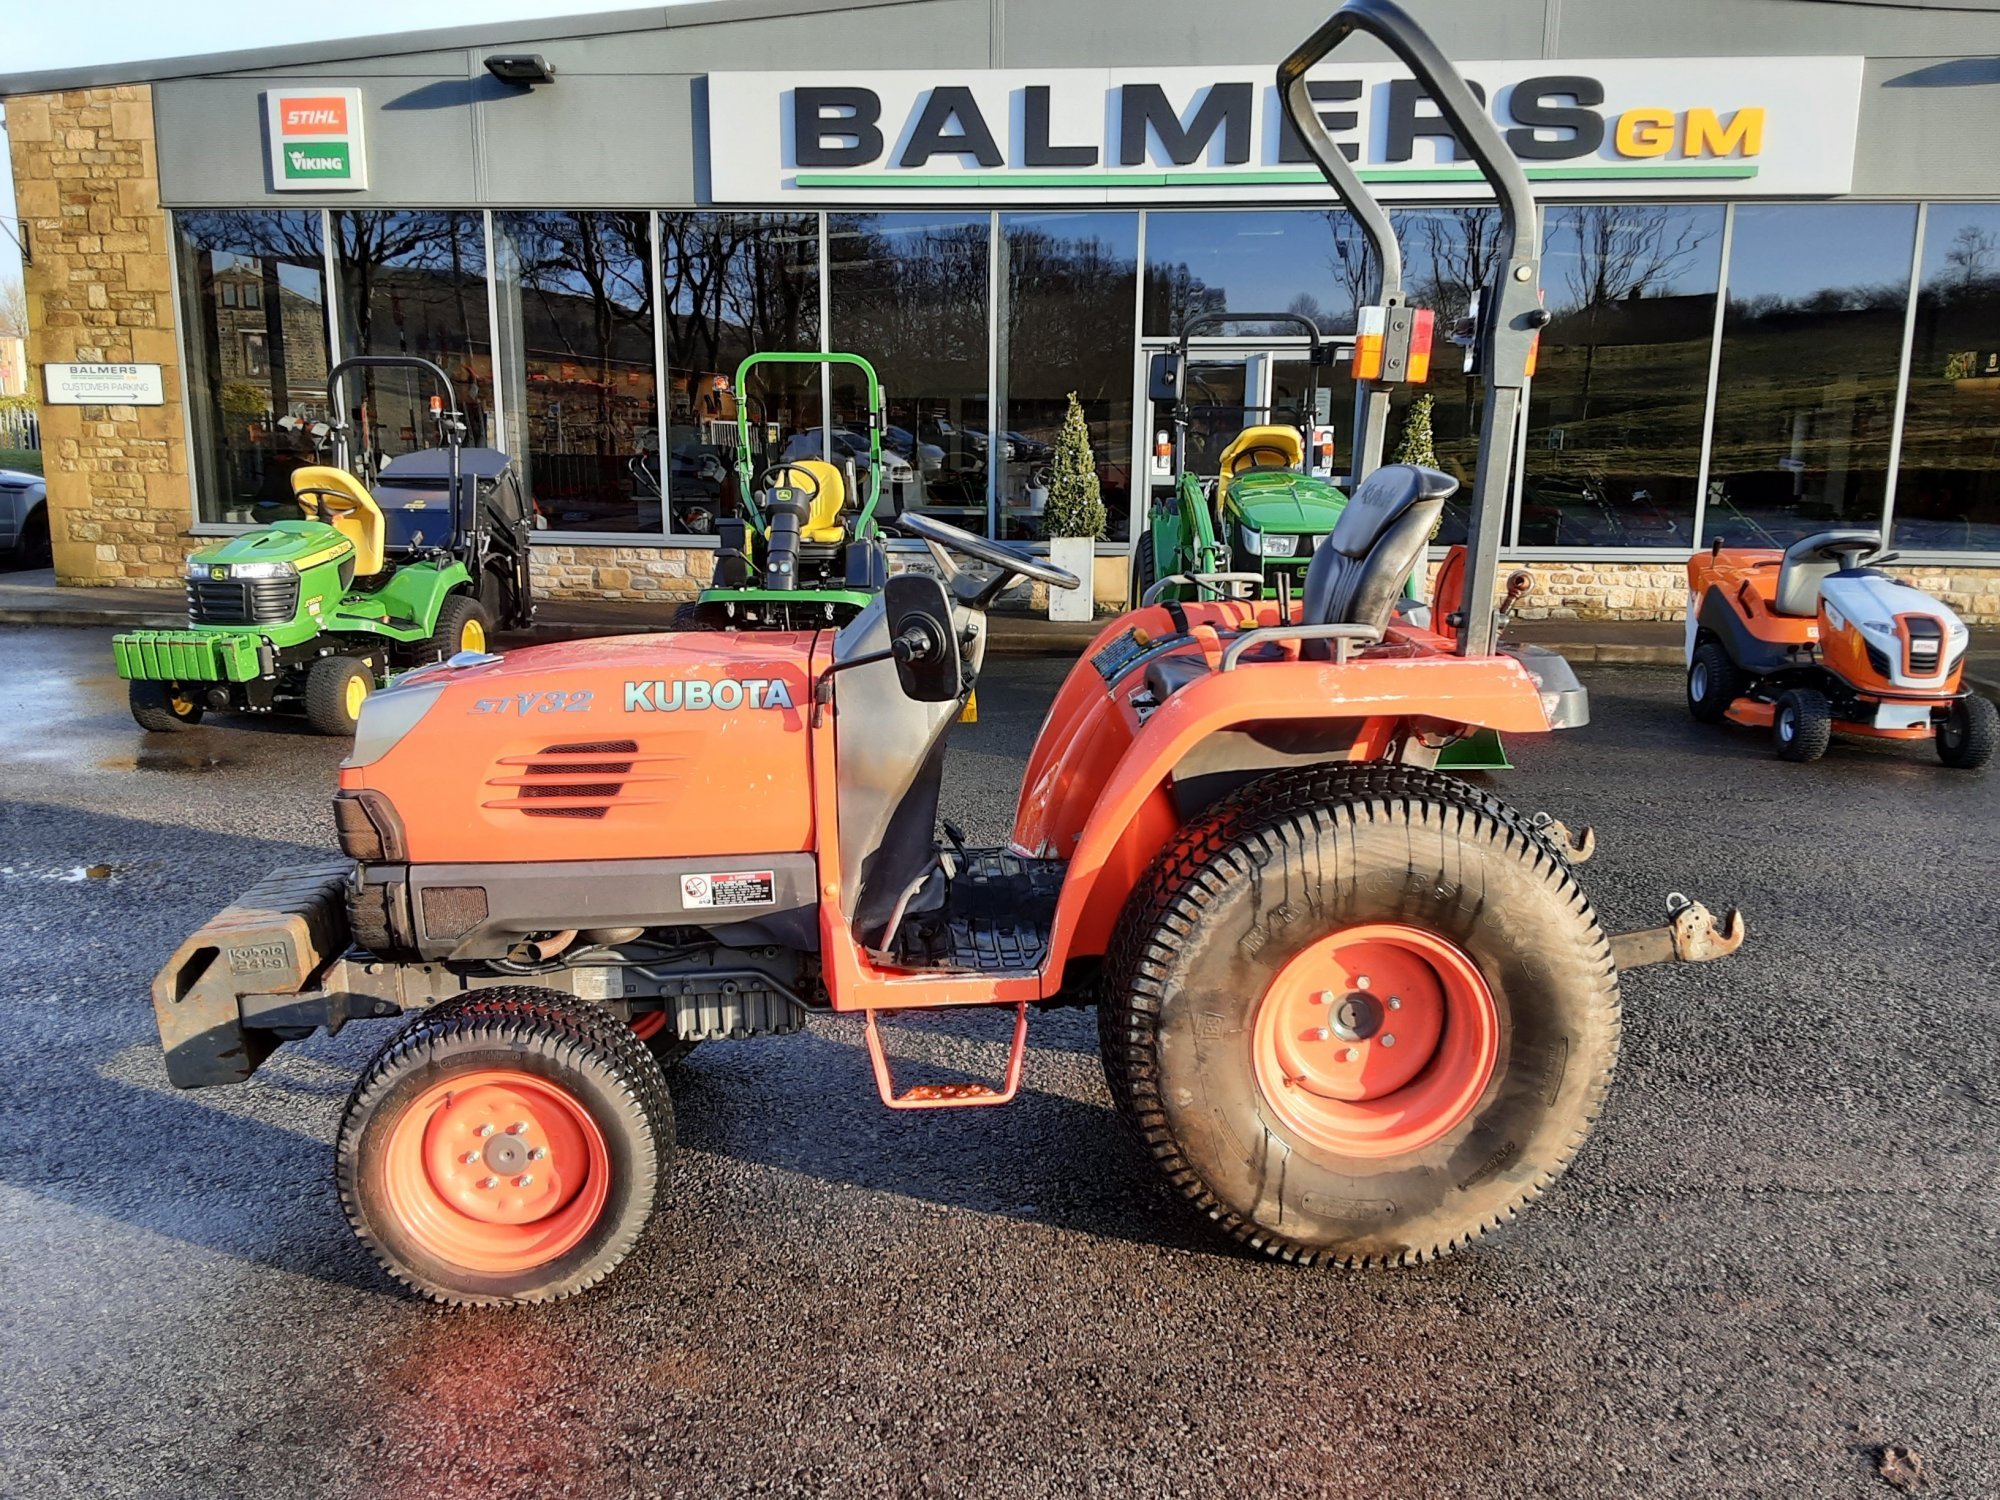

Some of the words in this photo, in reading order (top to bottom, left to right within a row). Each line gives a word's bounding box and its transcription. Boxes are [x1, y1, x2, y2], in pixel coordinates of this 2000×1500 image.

[287, 109, 340, 125] STIHL
[795, 75, 1604, 167] BALMERS
[1615, 107, 1764, 158] GM
[290, 155, 343, 170] VIKING
[70, 366, 137, 374] BALMERS
[62, 383, 110, 391] CUSTOMER
[111, 383, 149, 391] PARKING
[623, 678, 794, 712] KUBOTA
